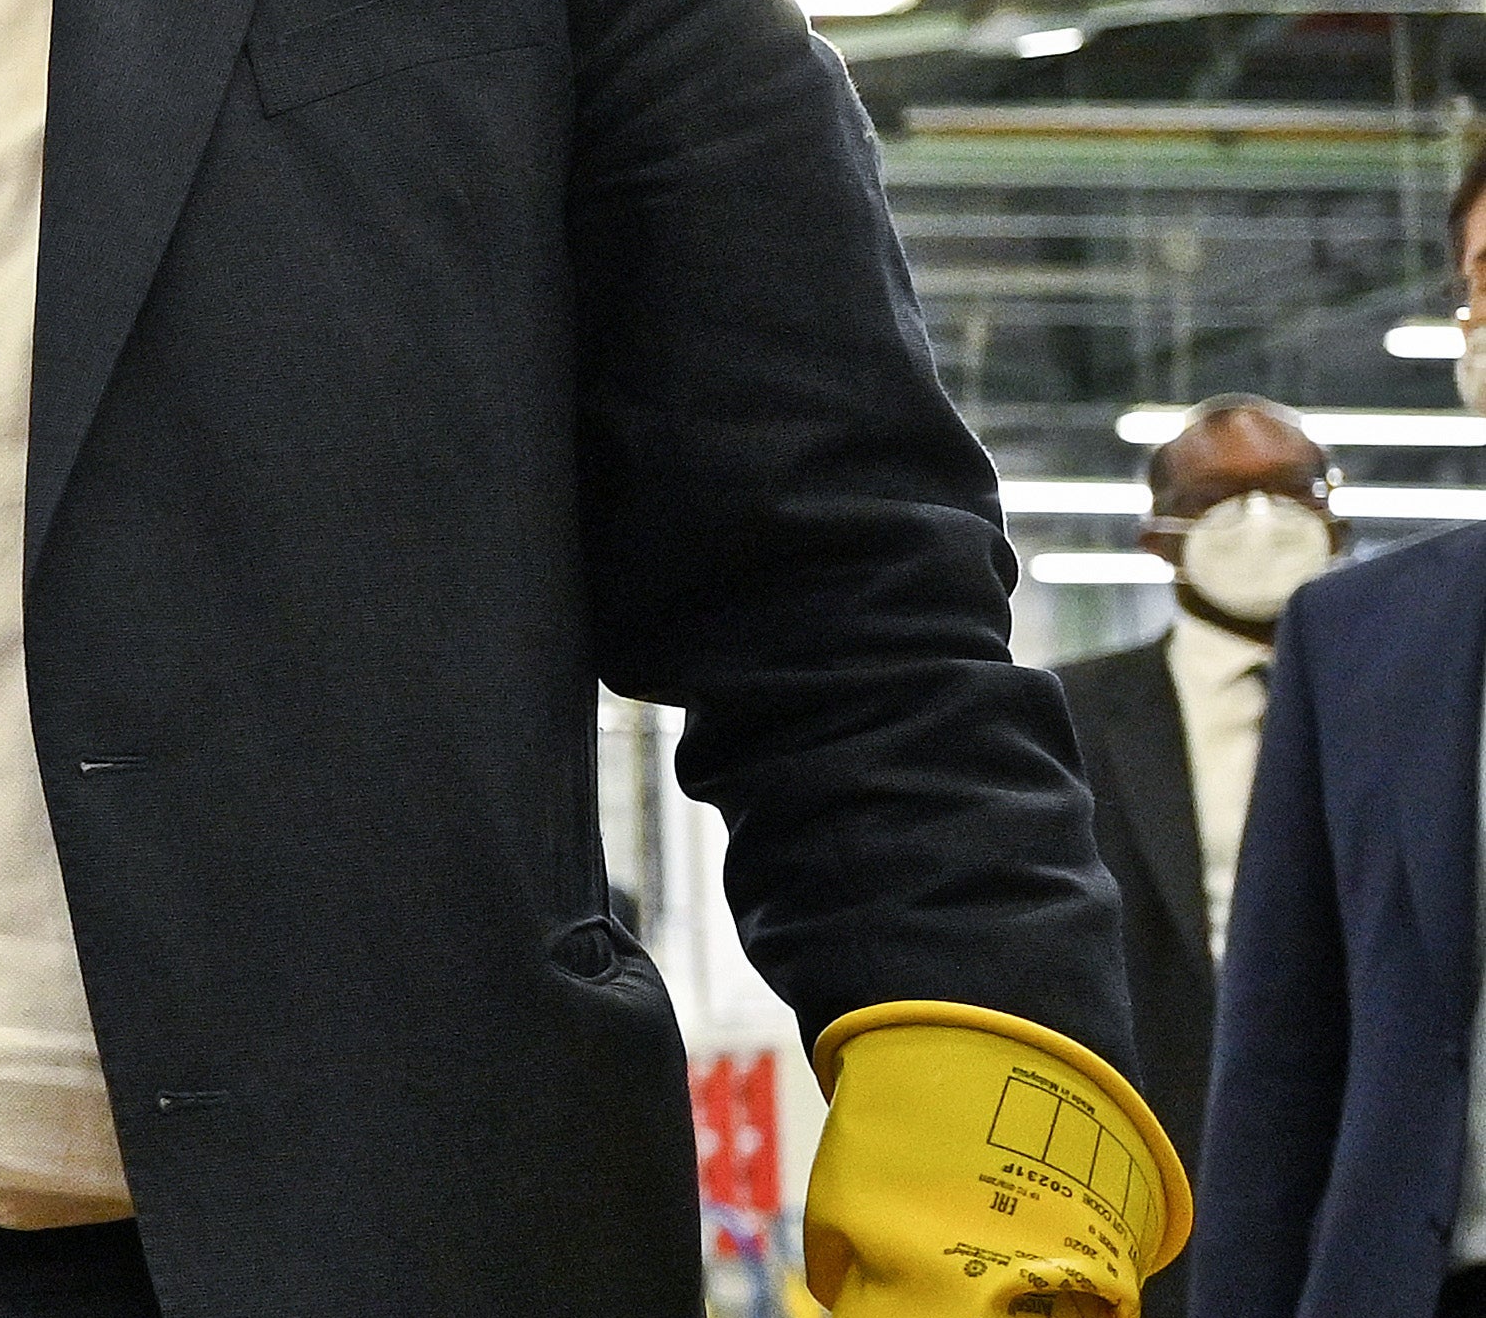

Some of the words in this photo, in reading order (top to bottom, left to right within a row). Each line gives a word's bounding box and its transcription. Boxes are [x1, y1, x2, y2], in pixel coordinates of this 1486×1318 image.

[1002, 1163, 1073, 1198] C0231F
[989, 1191, 1018, 1216] EAC
[1064, 1236, 1098, 1260] 2020
